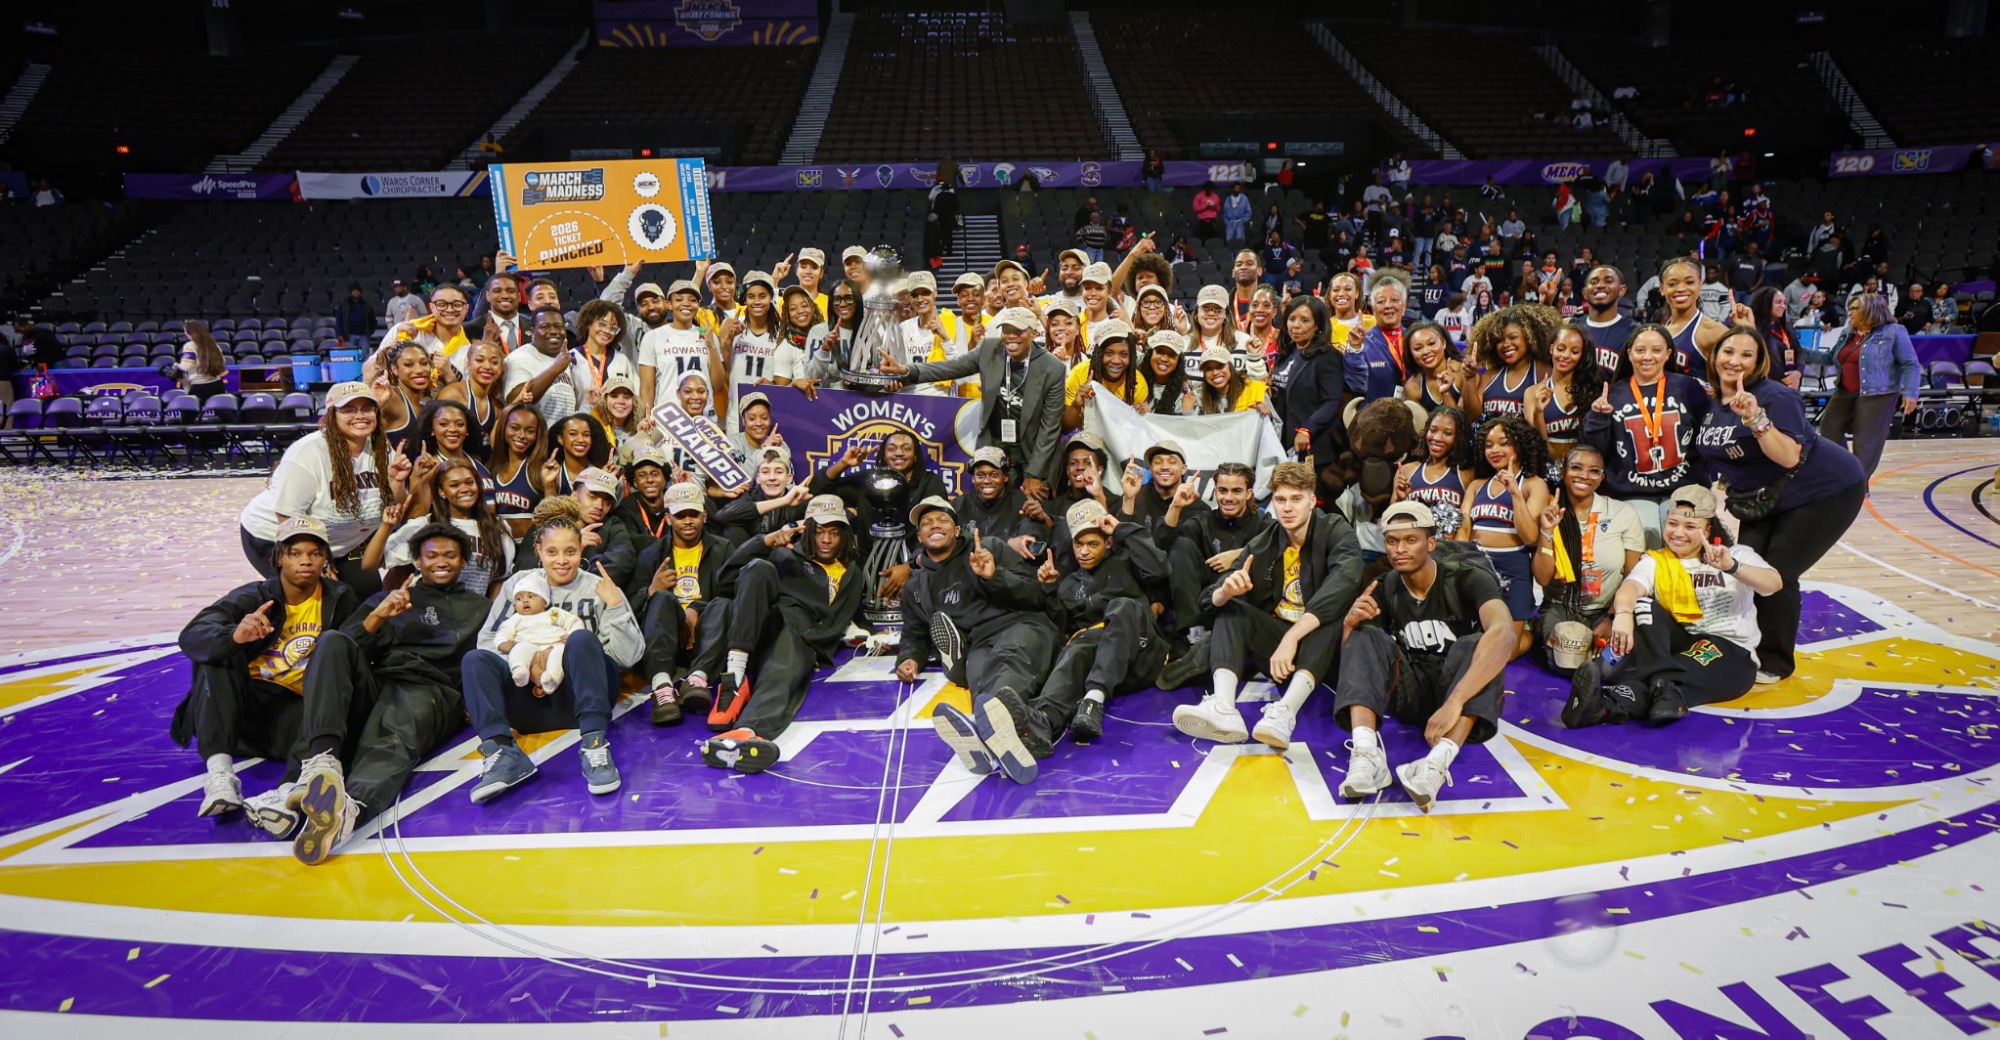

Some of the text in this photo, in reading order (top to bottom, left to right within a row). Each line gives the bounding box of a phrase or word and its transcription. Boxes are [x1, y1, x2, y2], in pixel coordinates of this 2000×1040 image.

[1835, 155, 1874, 173] 120
[540, 172, 582, 186] MARCH
[1208, 164, 1244, 182] 122
[218, 180, 256, 190] SpeedPro
[380, 175, 440, 187] WARDS CORNER
[382, 185, 440, 195] CHIROPRACTIC
[546, 184, 603, 198] MADNESS
[551, 221, 578, 236] 2026
[553, 232, 582, 246] TICKET
[540, 239, 603, 266] PUNCHED
[1425, 289, 1443, 300] HU
[908, 346, 932, 355] HOWA
[745, 355, 765, 377] 11
[1484, 399, 1524, 414] HOWAR
[831, 400, 936, 440] WOMEN'S
[695, 418, 731, 451] MEAC
[656, 405, 744, 487] CHAMPS
[1725, 444, 1745, 460] HU
[495, 491, 530, 509] WARD
